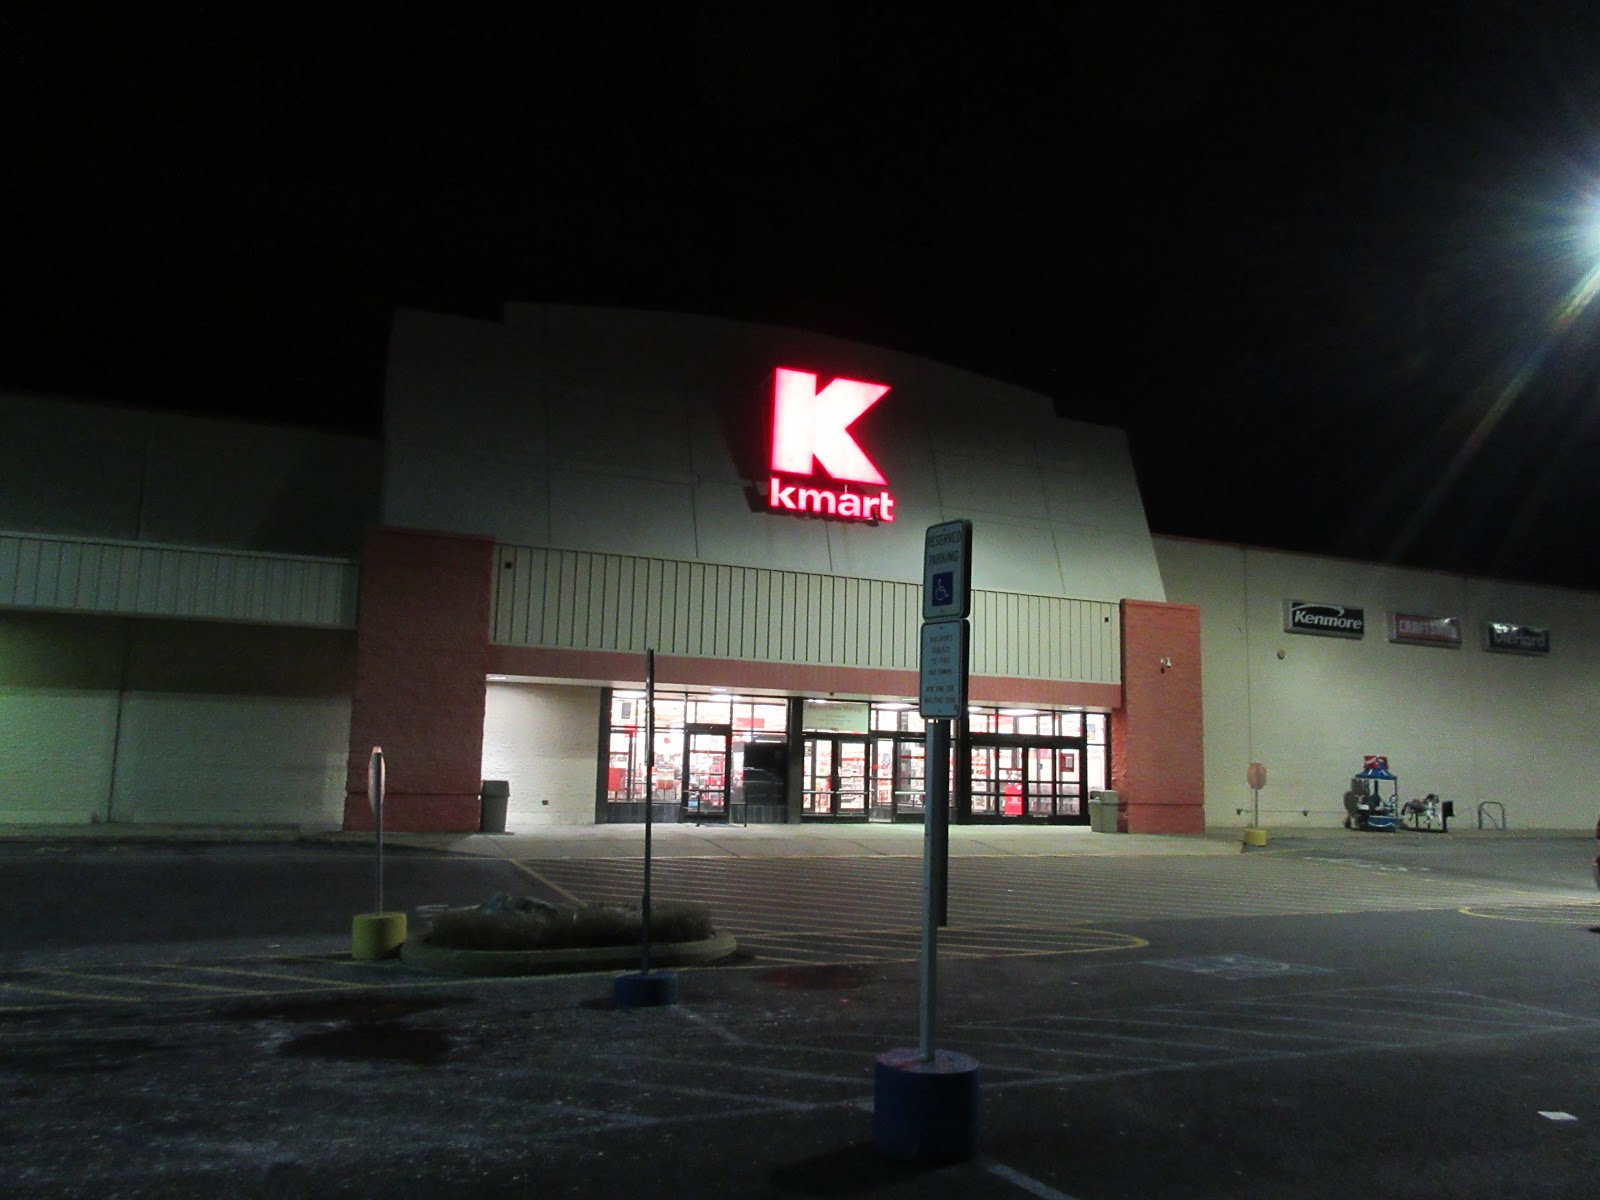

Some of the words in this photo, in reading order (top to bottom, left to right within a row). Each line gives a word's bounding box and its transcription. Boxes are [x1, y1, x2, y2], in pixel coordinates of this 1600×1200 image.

[771, 367, 892, 485] K
[769, 477, 895, 521] kmart
[1294, 610, 1363, 630] Kenmore
